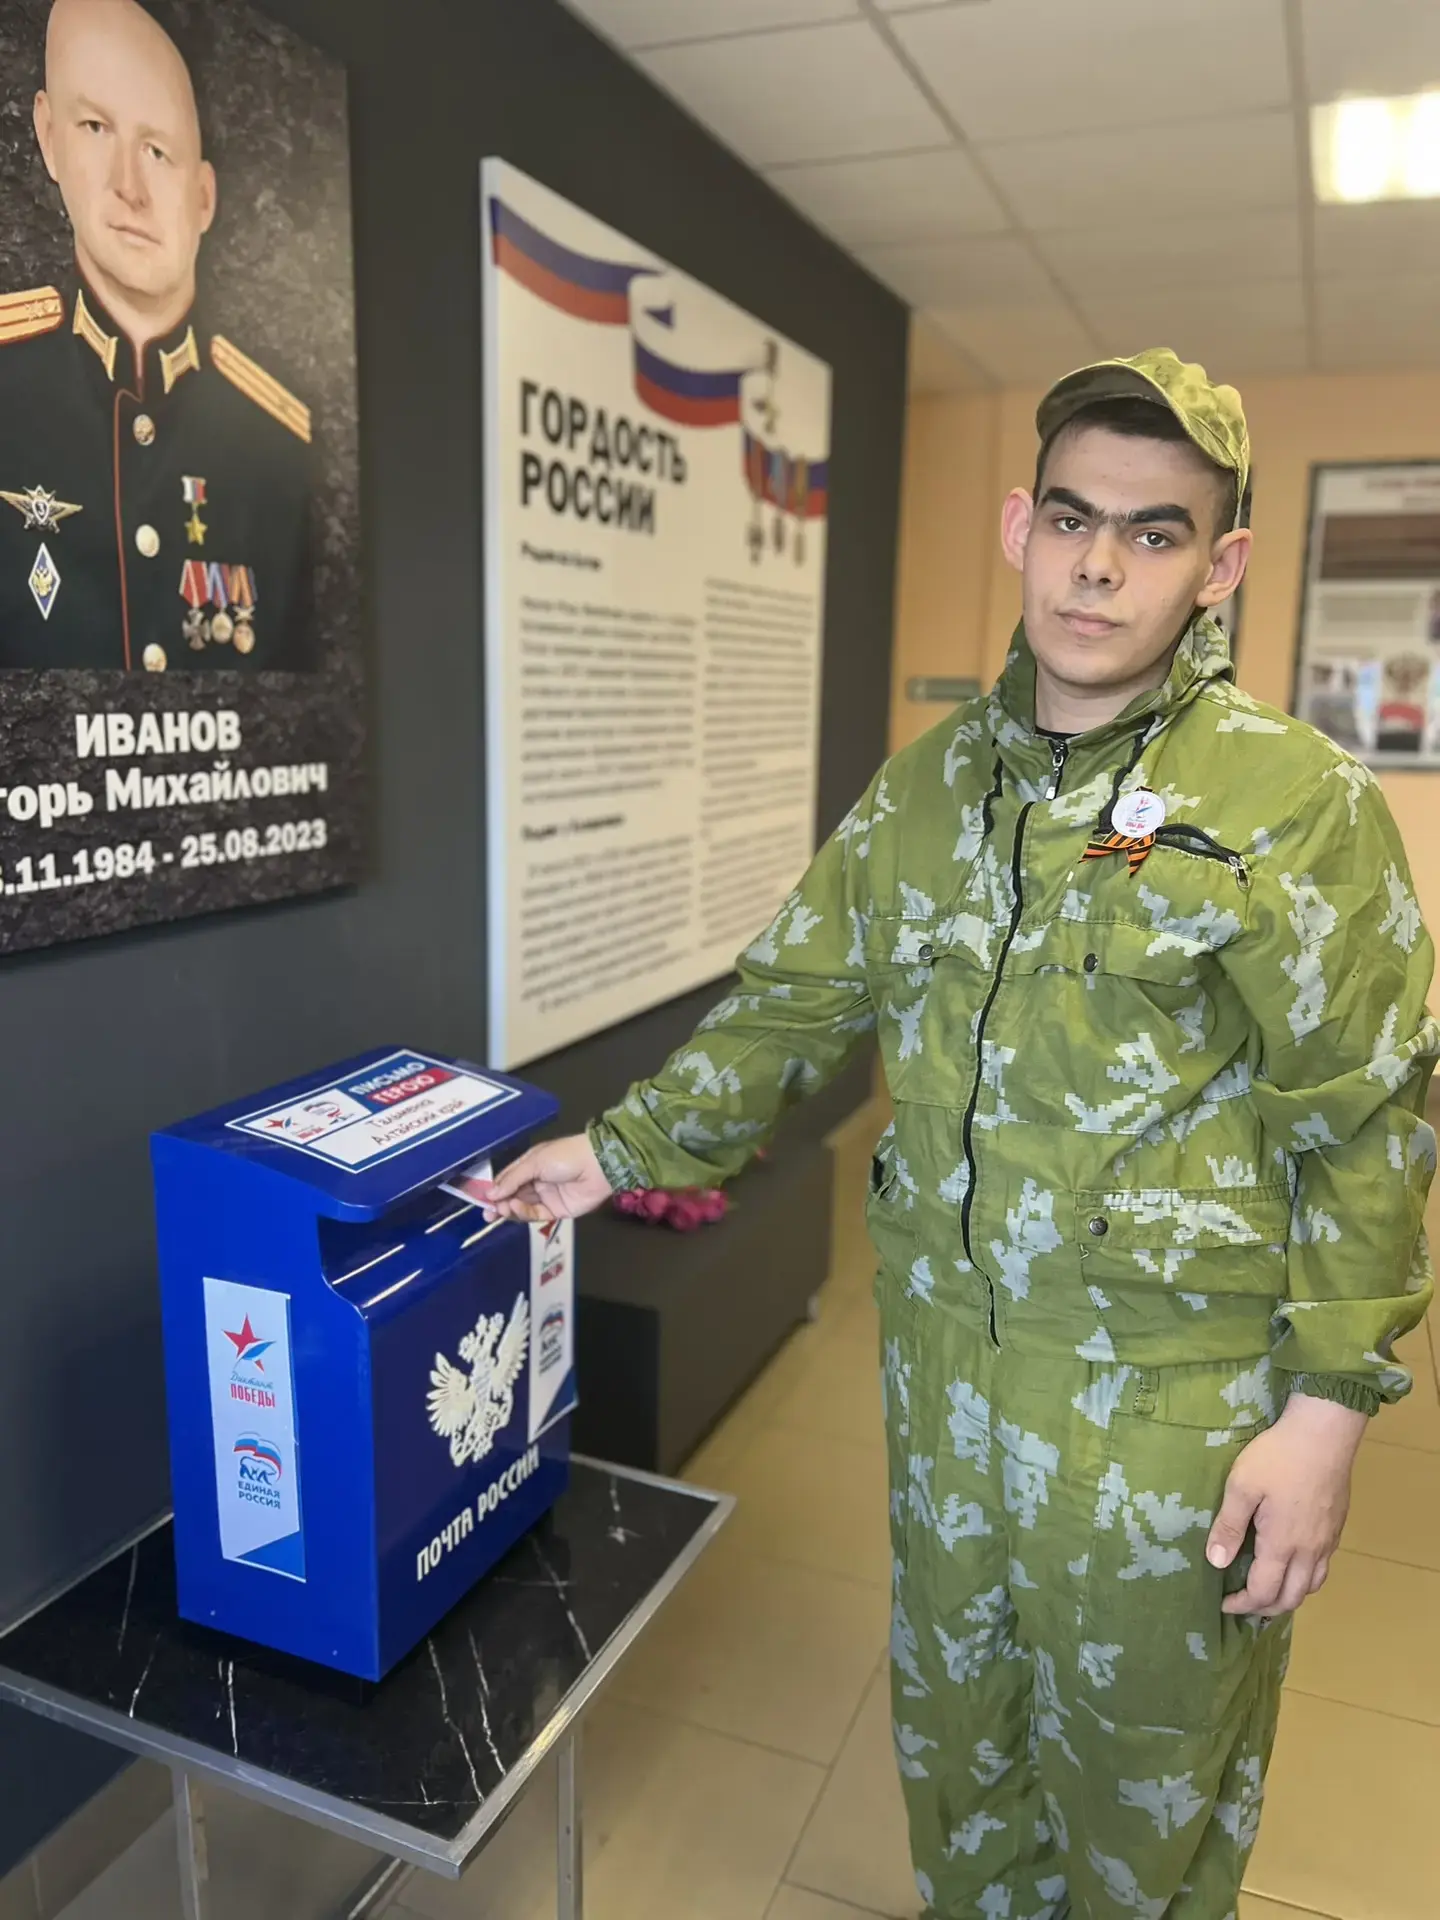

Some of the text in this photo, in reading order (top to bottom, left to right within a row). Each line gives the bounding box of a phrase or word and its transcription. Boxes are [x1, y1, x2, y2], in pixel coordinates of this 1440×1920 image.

[520, 378, 688, 485] ГОРДОСТЬ
[520, 449, 656, 537] РОССИИ
[75, 710, 242, 758] ИВАНОВ
[105, 760, 328, 811] Михайлович
[0, 841, 155, 897] .11.1984
[181, 818, 328, 867] 25.08.2023
[348, 1061, 426, 1095] ПИСЬМО
[372, 1074, 435, 1104] ГЕРОЮ
[230, 1383, 276, 1408] ПОБЕДЫ
[238, 1481, 280, 1498] ЕДИНАЯ
[238, 1491, 281, 1509] РОССИЯ
[417, 1442, 540, 1582] ПОЧТА РОССИИ
